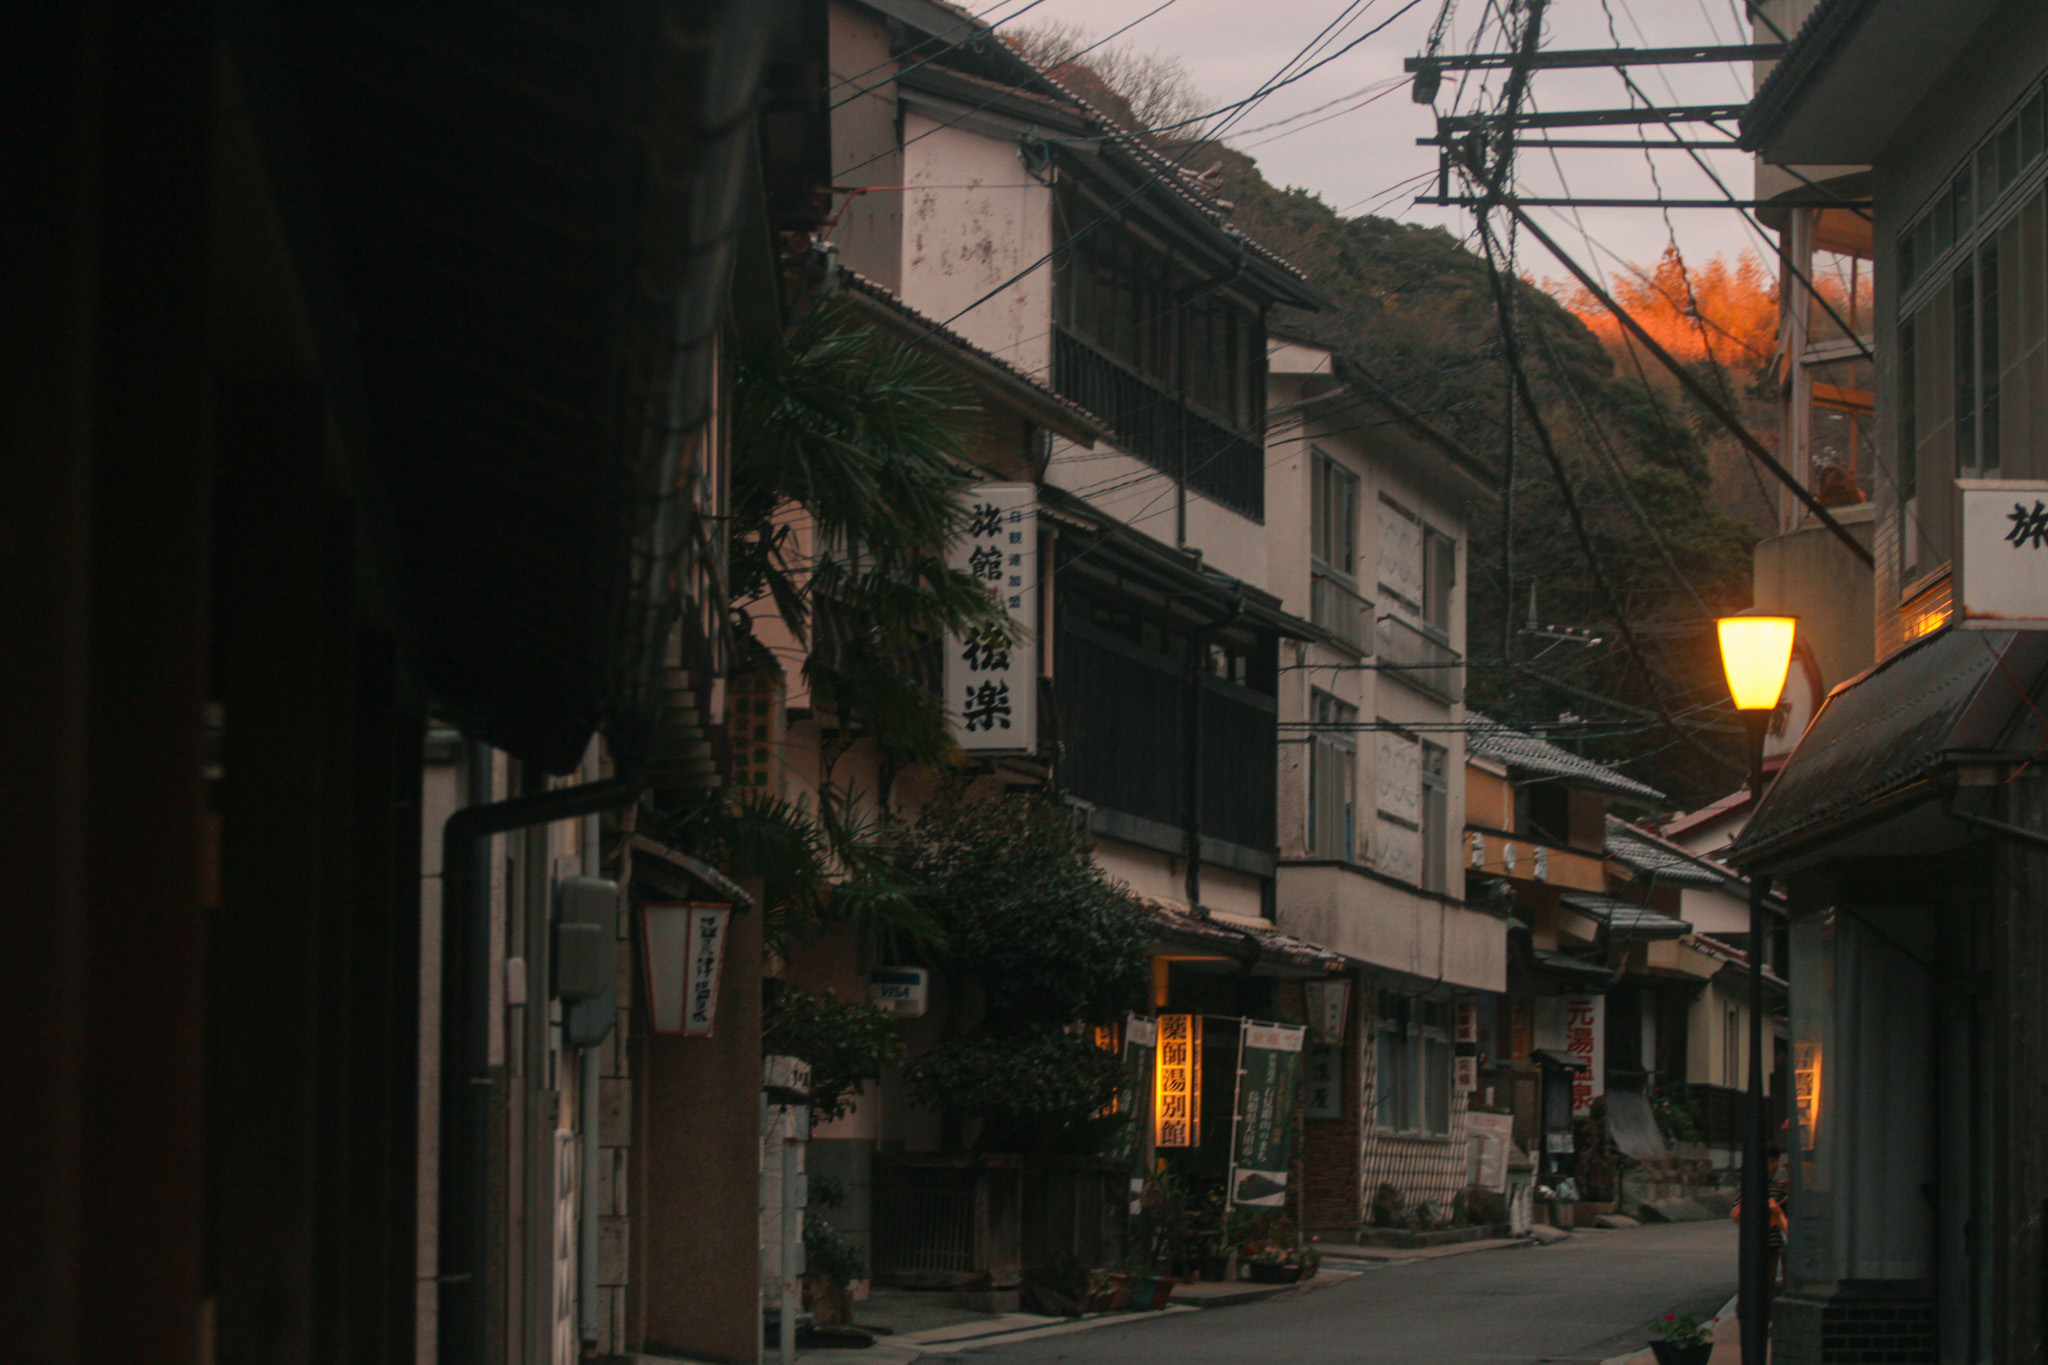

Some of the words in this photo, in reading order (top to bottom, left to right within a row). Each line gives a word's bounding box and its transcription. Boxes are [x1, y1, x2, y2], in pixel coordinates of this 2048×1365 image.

[969, 503, 1003, 581] 旅館
[962, 621, 1013, 732] 後楽
[1160, 1015, 1188, 1146] 薬師湯別館
